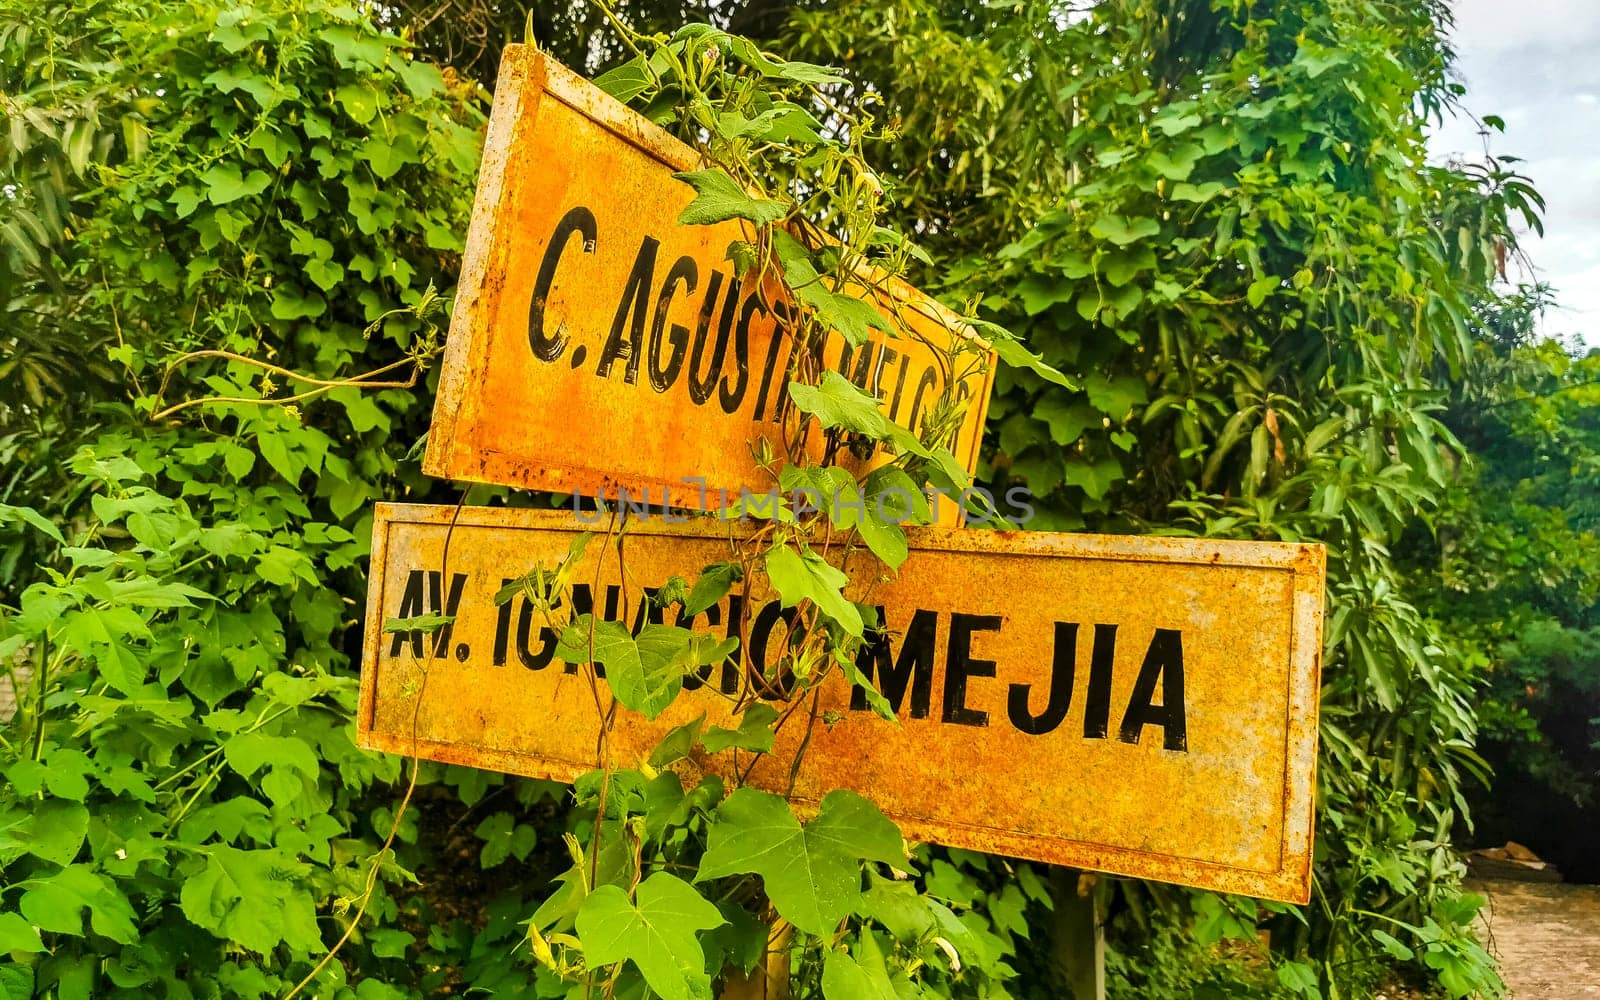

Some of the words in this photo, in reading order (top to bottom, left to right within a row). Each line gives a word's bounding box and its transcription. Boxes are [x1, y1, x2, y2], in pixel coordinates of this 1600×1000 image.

[528, 206, 598, 370] C.
[596, 235, 827, 430] AGUSTI
[390, 569, 471, 663] AV.
[849, 604, 1188, 753] MEJIA
